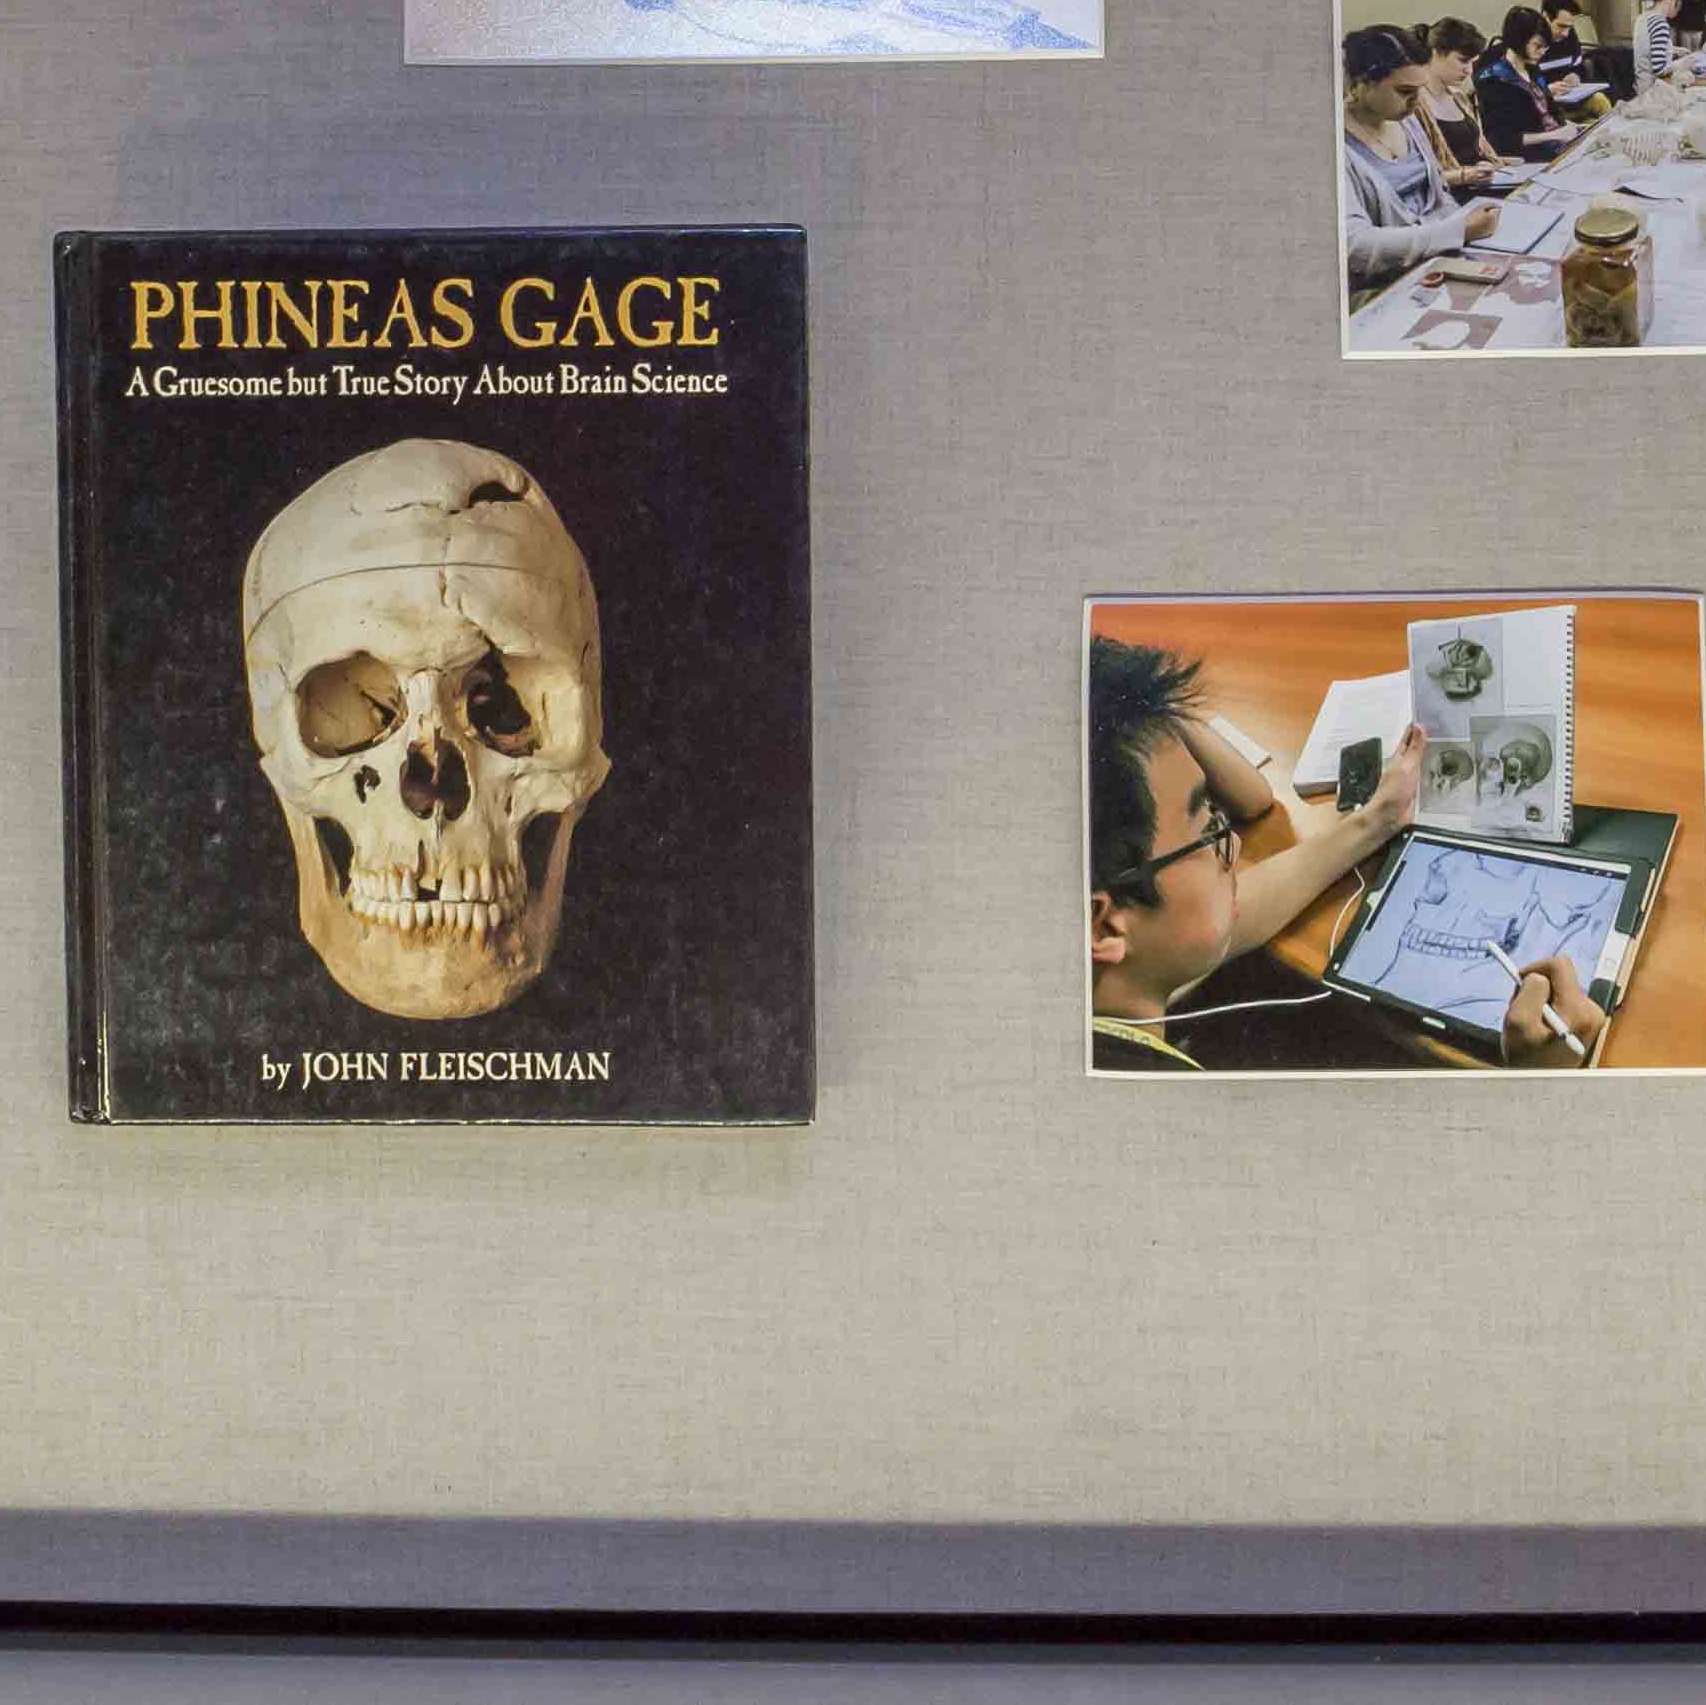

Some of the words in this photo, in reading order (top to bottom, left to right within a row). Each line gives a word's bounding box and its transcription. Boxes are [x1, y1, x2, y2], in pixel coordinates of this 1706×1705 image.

[130, 277, 474, 349] PHINEAS
[500, 276, 720, 348] GAGE
[124, 365, 150, 397] A
[153, 365, 283, 397] Gruesome
[286, 366, 328, 396] but
[331, 365, 390, 396] True
[393, 364, 468, 405] Story
[472, 363, 555, 395] About
[559, 363, 627, 394] Brain
[631, 362, 728, 394] Science
[261, 1053, 291, 1090] by
[302, 1052, 389, 1090] JOHN
[399, 1051, 611, 1081] FLEISCHMAN
